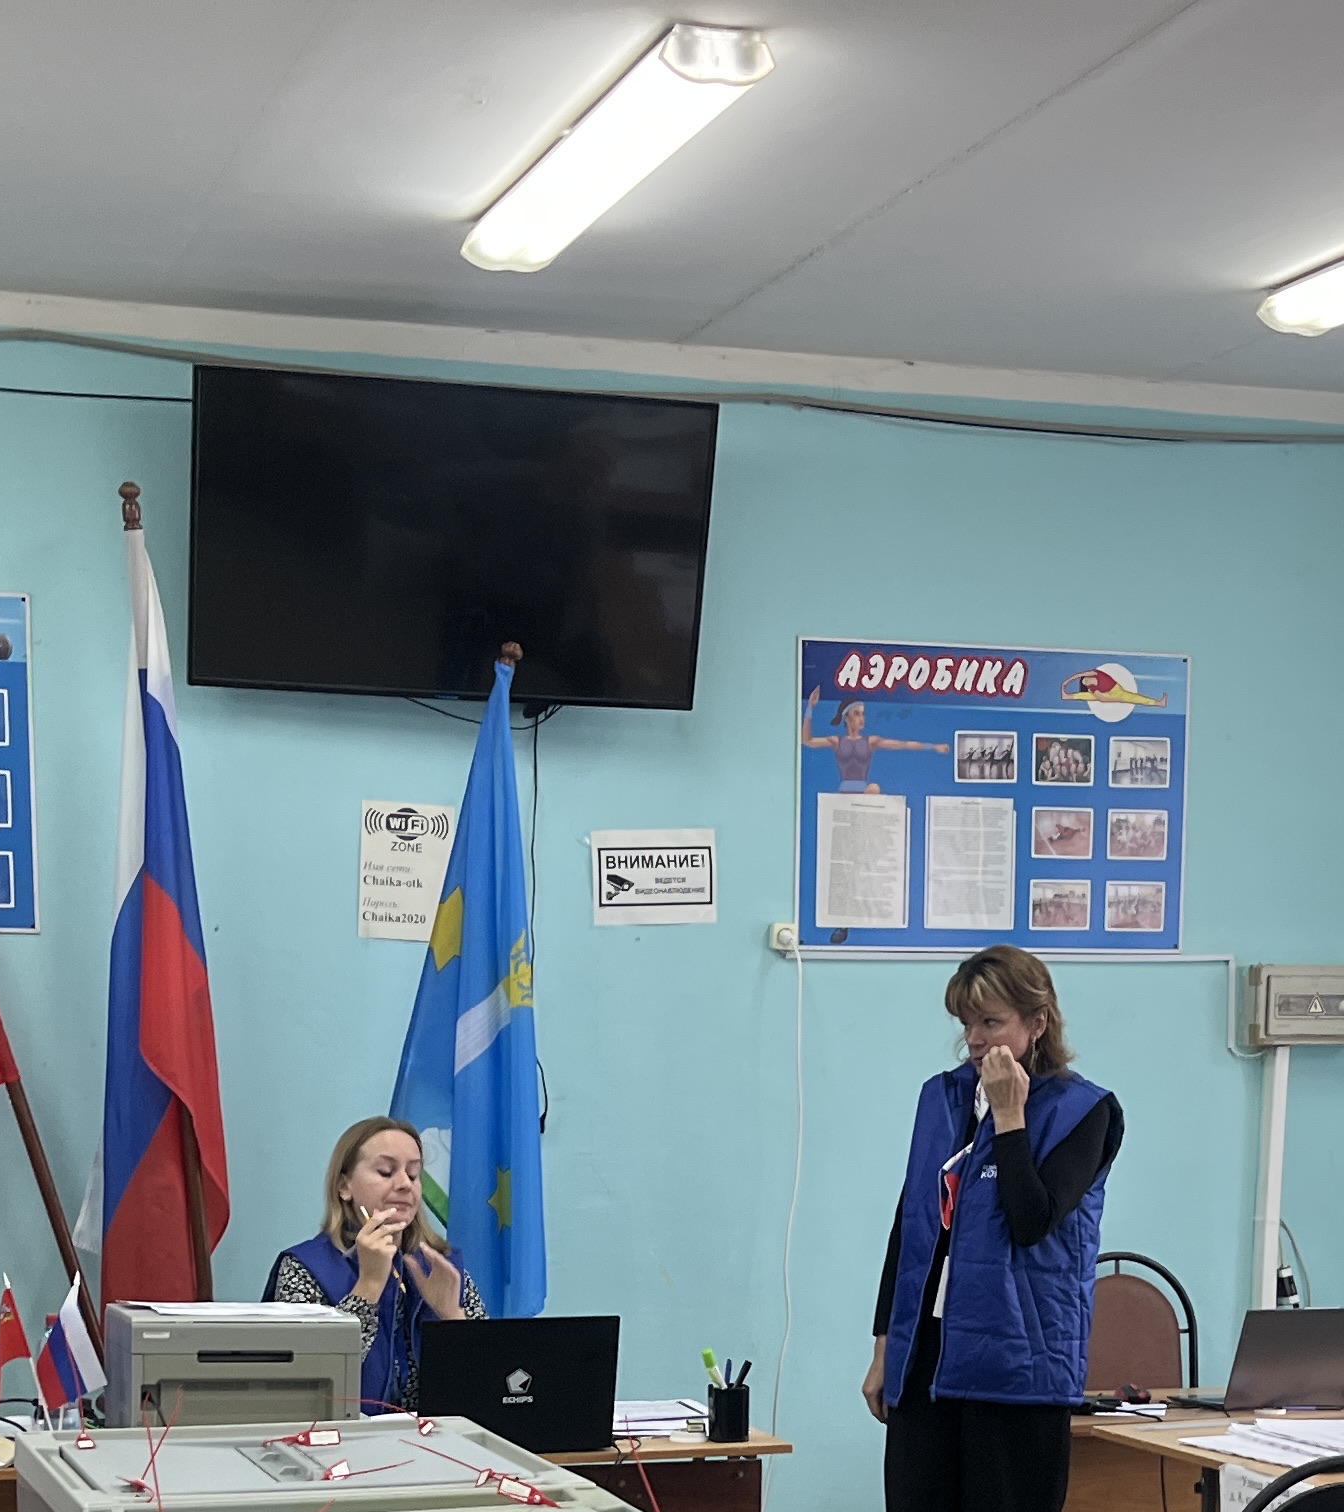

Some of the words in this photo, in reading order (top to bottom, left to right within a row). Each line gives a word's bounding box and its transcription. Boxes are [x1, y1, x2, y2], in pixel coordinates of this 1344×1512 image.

[837, 653, 1025, 695] АЭРОБИКА
[390, 841, 423, 853] ZONE
[605, 854, 705, 869] ВНИМАНИЕ!
[363, 875, 423, 888] Chaika-otk
[362, 910, 426, 924] Chaika2020
